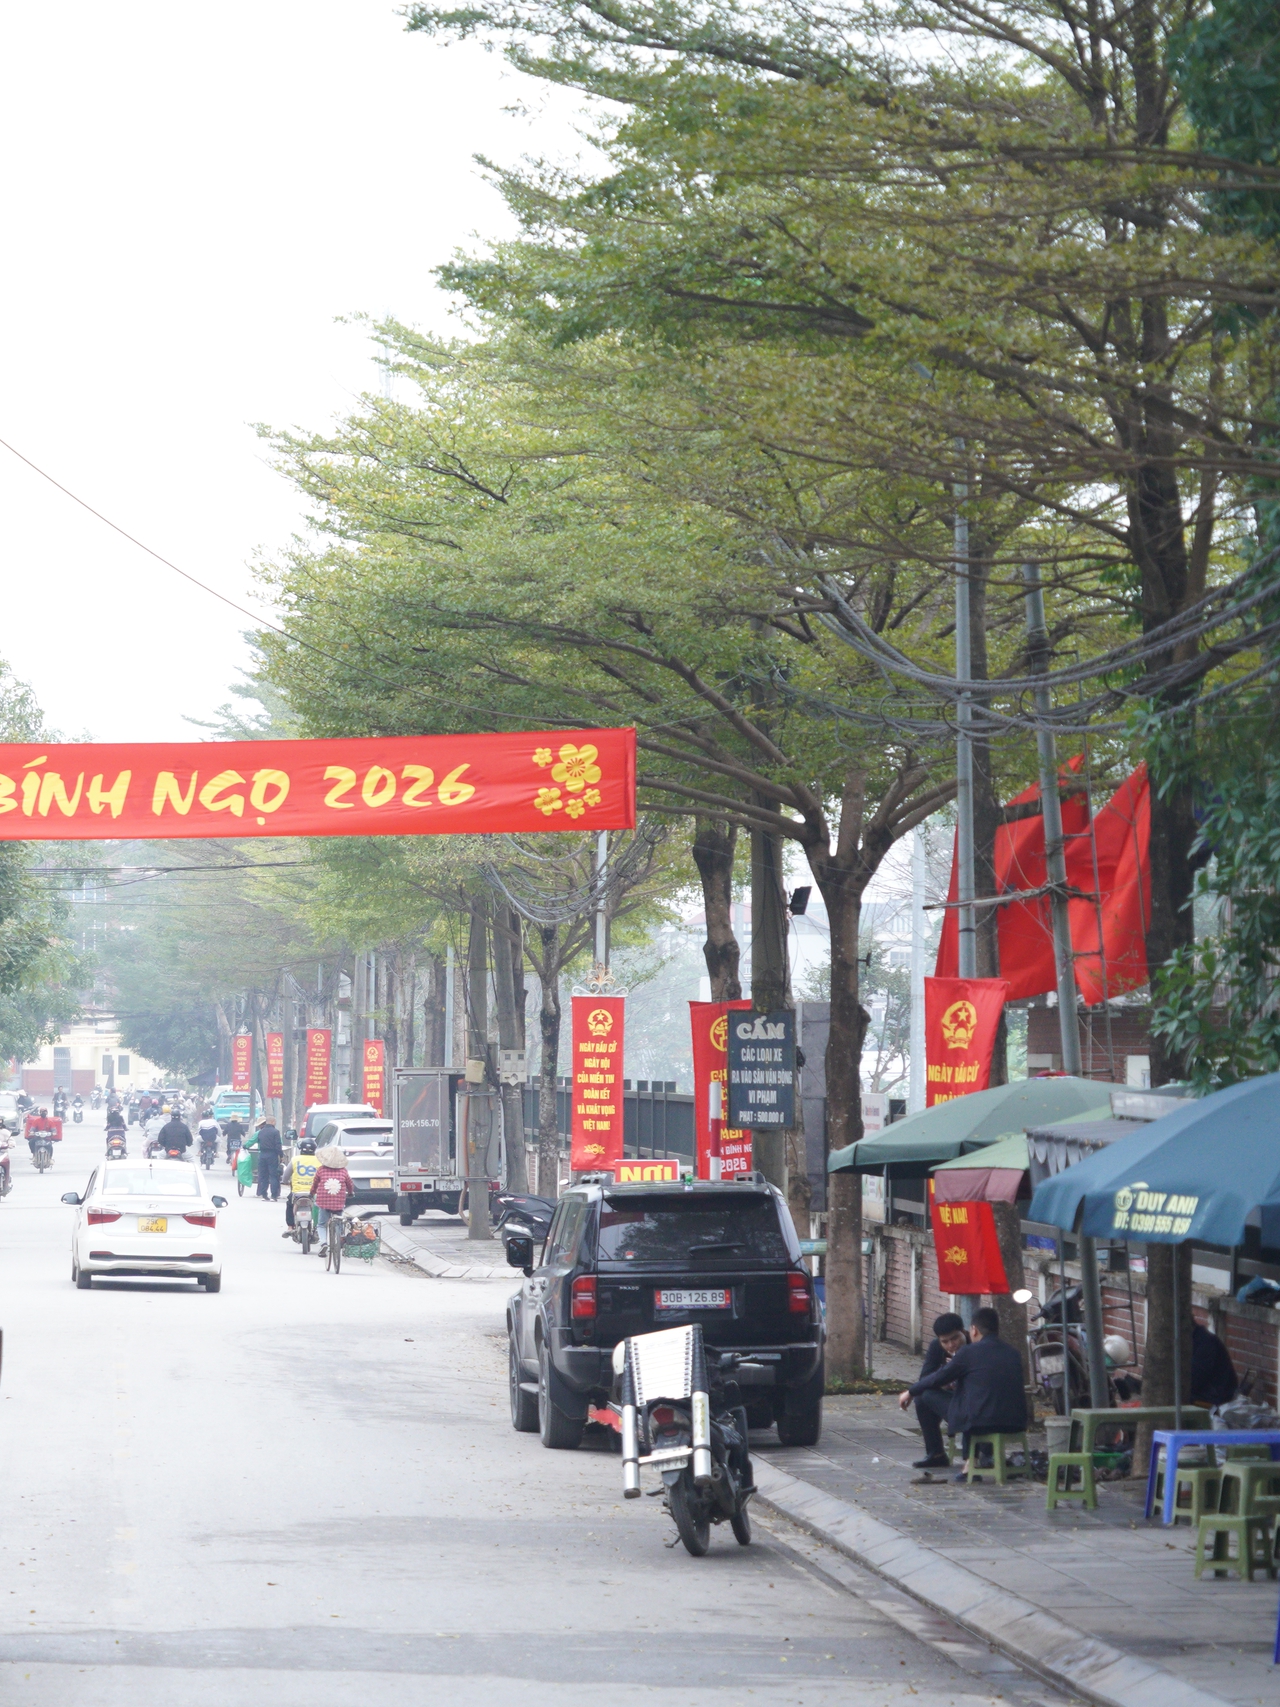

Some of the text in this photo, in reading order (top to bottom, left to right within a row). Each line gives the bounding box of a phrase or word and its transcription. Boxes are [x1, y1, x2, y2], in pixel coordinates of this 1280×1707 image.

[152, 768, 291, 826] NGỌ
[323, 763, 476, 809] 2026
[736, 1015, 785, 1040] CẤM
[579, 1041, 595, 1052] NGÀY
[608, 1040, 617, 1053] CỬ
[741, 1045, 783, 1063] CÁC LOẠI XE
[584, 1056, 610, 1070] NGÀY HỘI
[577, 1071, 589, 1083] CỦA
[605, 1074, 615, 1084] TIN
[732, 1067, 793, 1086] RA VÀO SÂN VẬN ĐỘNG
[928, 1062, 953, 1083] NGÀY
[967, 1060, 980, 1083] CỬ
[583, 1087, 610, 1099] ĐOÀN KẾT
[748, 1090, 777, 1106] VI PHẠM
[577, 1103, 615, 1117] VÀ KHÁT VỌNG
[739, 1110, 754, 1124] PHẠT
[757, 1111, 779, 1122] 500.000
[401, 1119, 440, 1128] 29K-156.70
[582, 1118, 611, 1131] VIỆT NAM!
[725, 1143, 743, 1155] BÍNH
[296, 1161, 317, 1177] be
[720, 1158, 747, 1173] 2026
[620, 1165, 672, 1182] NƠI
[1136, 1190, 1199, 1216] DUY ANH
[662, 1292, 725, 1303] 30B-126.89
